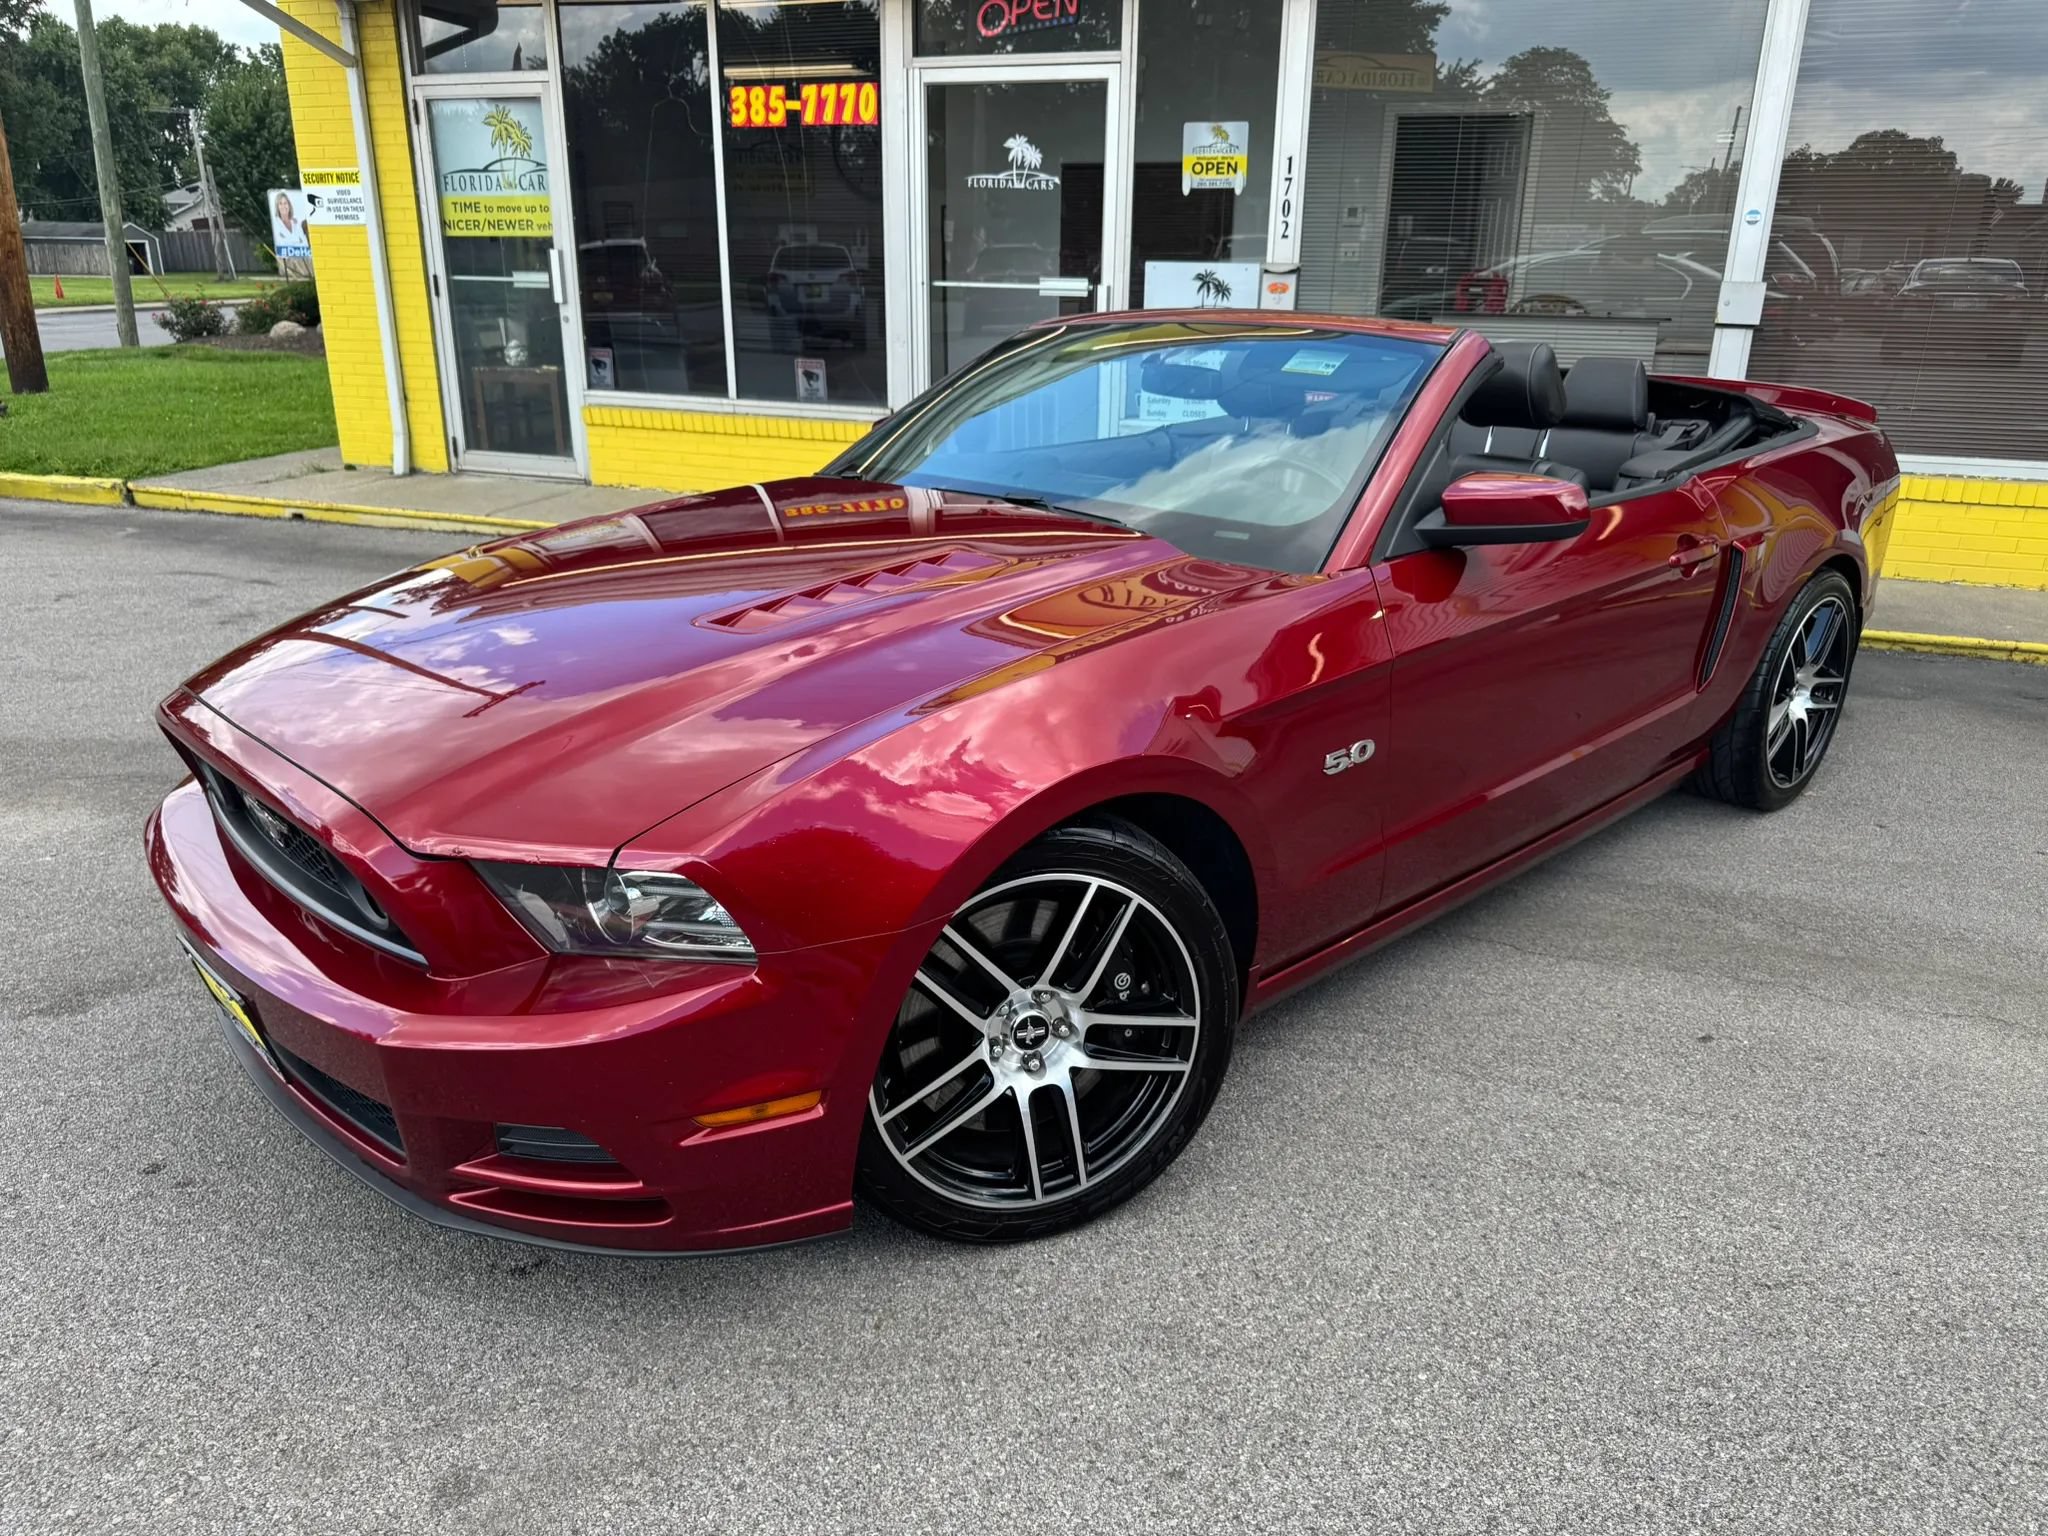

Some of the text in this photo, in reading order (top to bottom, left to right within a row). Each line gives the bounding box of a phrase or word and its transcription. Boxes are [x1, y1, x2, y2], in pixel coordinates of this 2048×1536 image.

[976, 0, 1079, 38] OPEN
[730, 82, 876, 125] 385-7770
[1192, 161, 1238, 175] OPEN
[303, 172, 360, 184] SECURITY NOTICE
[443, 175, 503, 192] FLORIDA
[967, 178, 1054, 190] FLORIDA CARS
[1281, 155, 1293, 239] 1702
[451, 202, 550, 216] TIME to move up to
[442, 218, 534, 232] NICER/NEWER
[1322, 739, 1375, 775] 5.0
